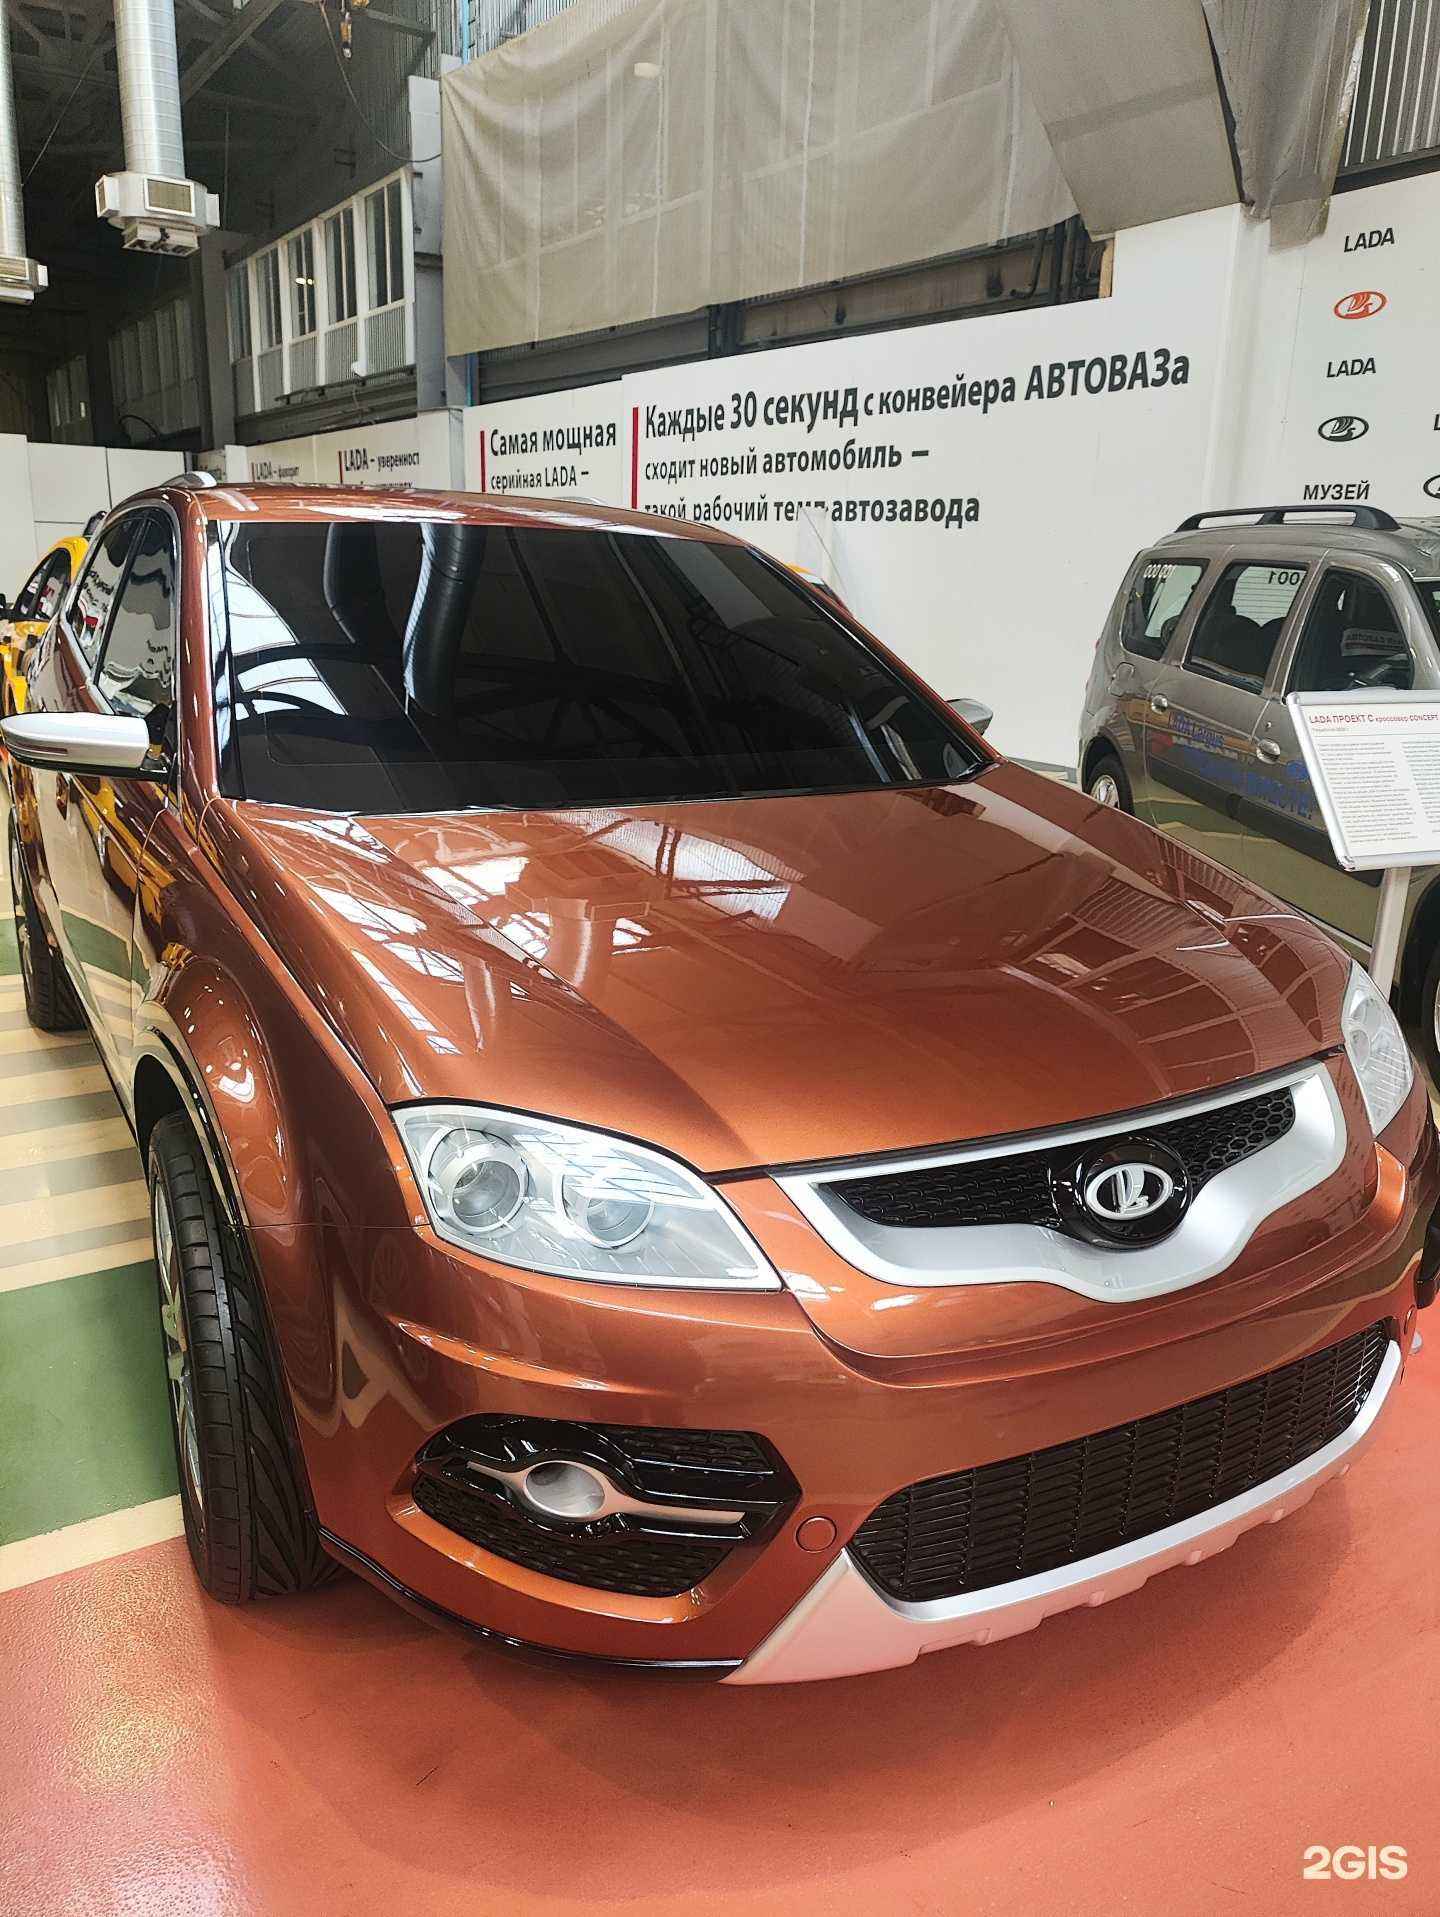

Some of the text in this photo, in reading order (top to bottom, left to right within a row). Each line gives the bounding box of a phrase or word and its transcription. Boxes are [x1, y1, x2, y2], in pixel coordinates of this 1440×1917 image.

[1344, 227, 1395, 253] LADA
[1326, 357, 1376, 378] LADA
[645, 348, 1190, 442] Каждые 30 секунд с конвейера АВТОВАЗа
[490, 422, 616, 456] Самая мощная
[345, 448, 368, 472] LADA
[645, 459, 696, 485] сходит
[700, 446, 757, 477] новый
[763, 438, 902, 474] автомобиль
[491, 469, 542, 493] серийная
[545, 465, 577, 487] LADA
[1303, 479, 1371, 500] МУЗЕЙ
[693, 494, 768, 522] рабочий
[831, 497, 980, 529] автозавода
[1309, 714, 1332, 724] LADA
